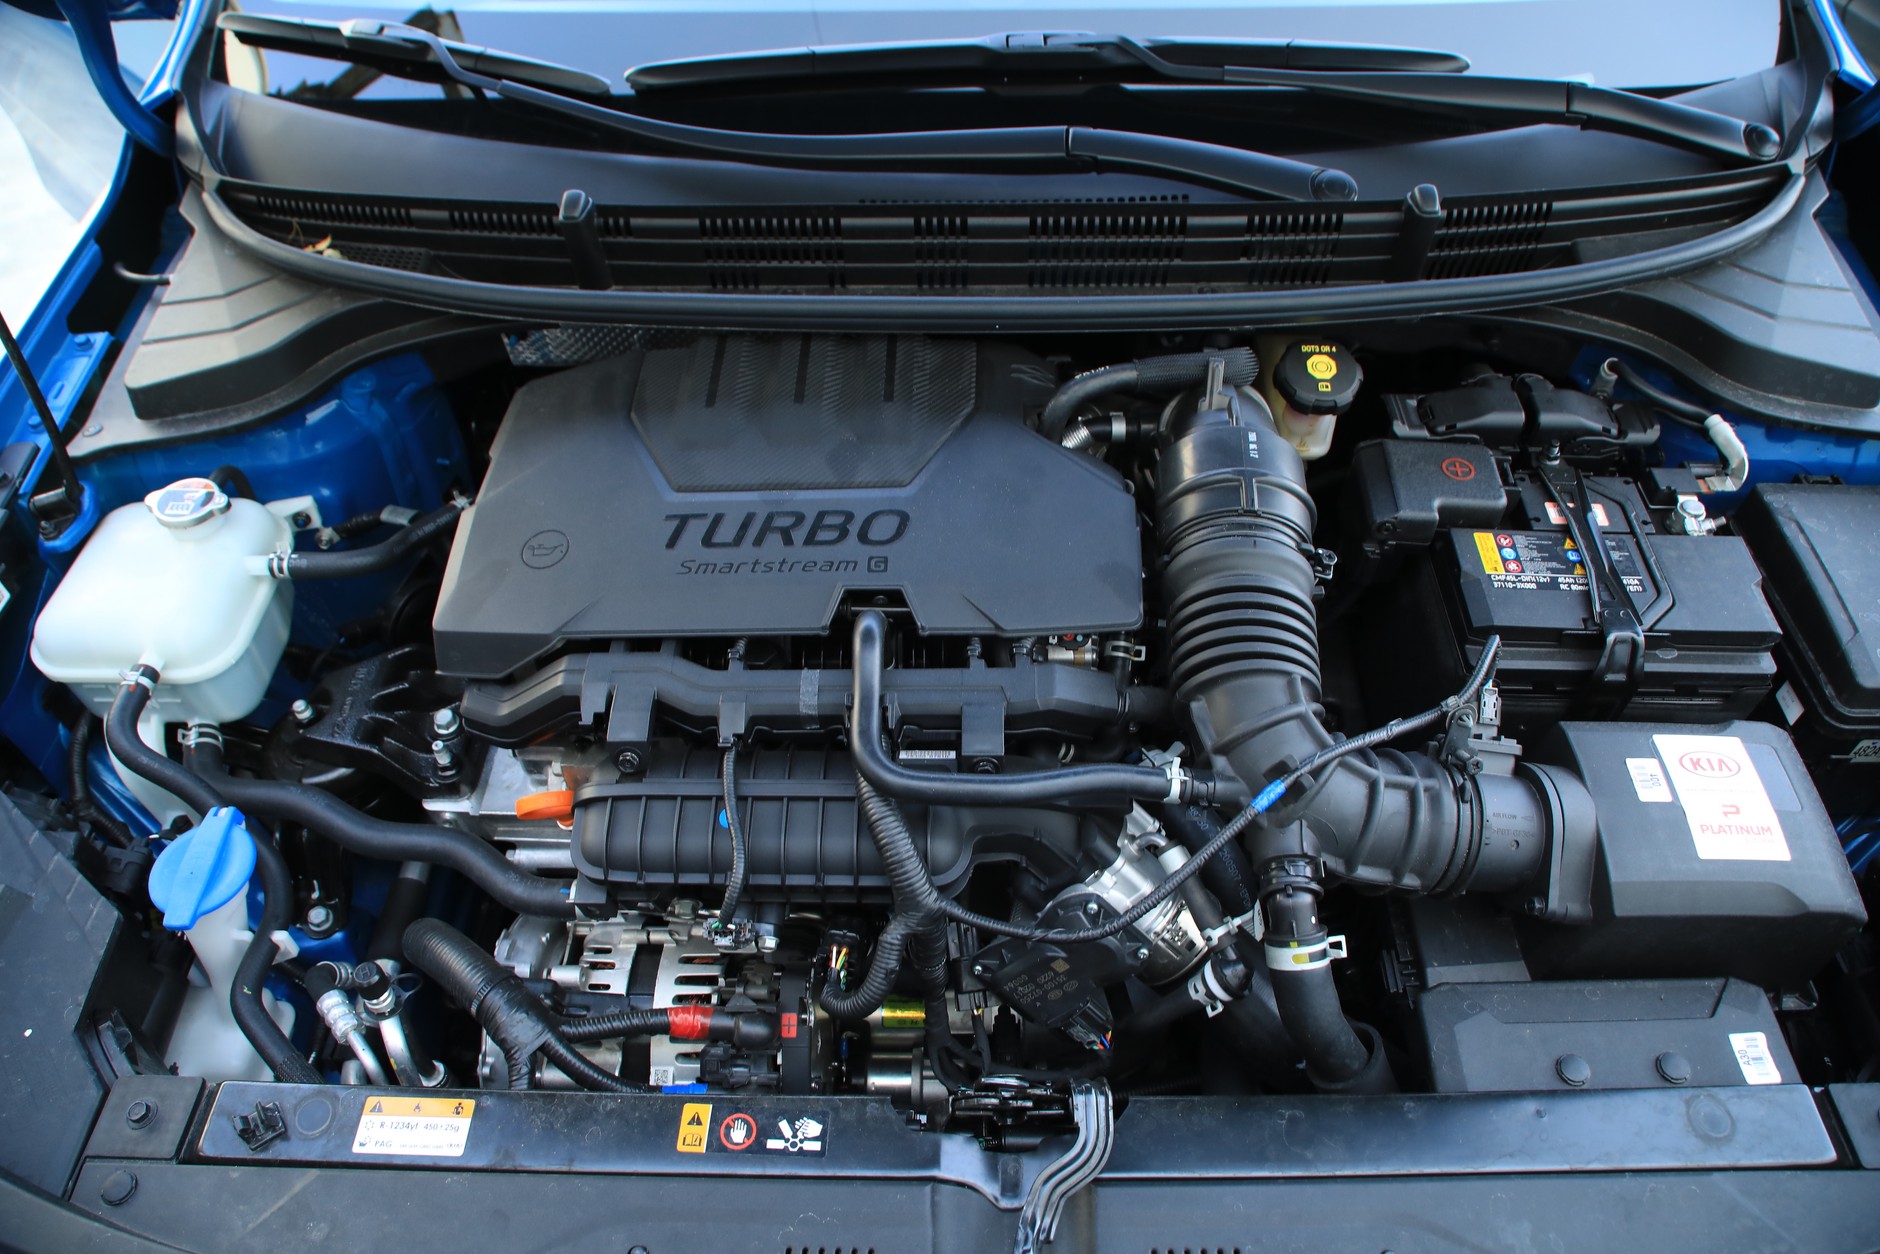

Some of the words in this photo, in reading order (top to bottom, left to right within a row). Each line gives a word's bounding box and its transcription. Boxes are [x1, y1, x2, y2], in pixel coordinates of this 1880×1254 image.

[664, 508, 911, 549] TURBO
[676, 556, 859, 576] Smartstream
[1688, 757, 1733, 772] KIA
[1699, 823, 1774, 836] PLATINUM
[1737, 1049, 1752, 1066] A30
[374, 1140, 393, 1148] PAG
